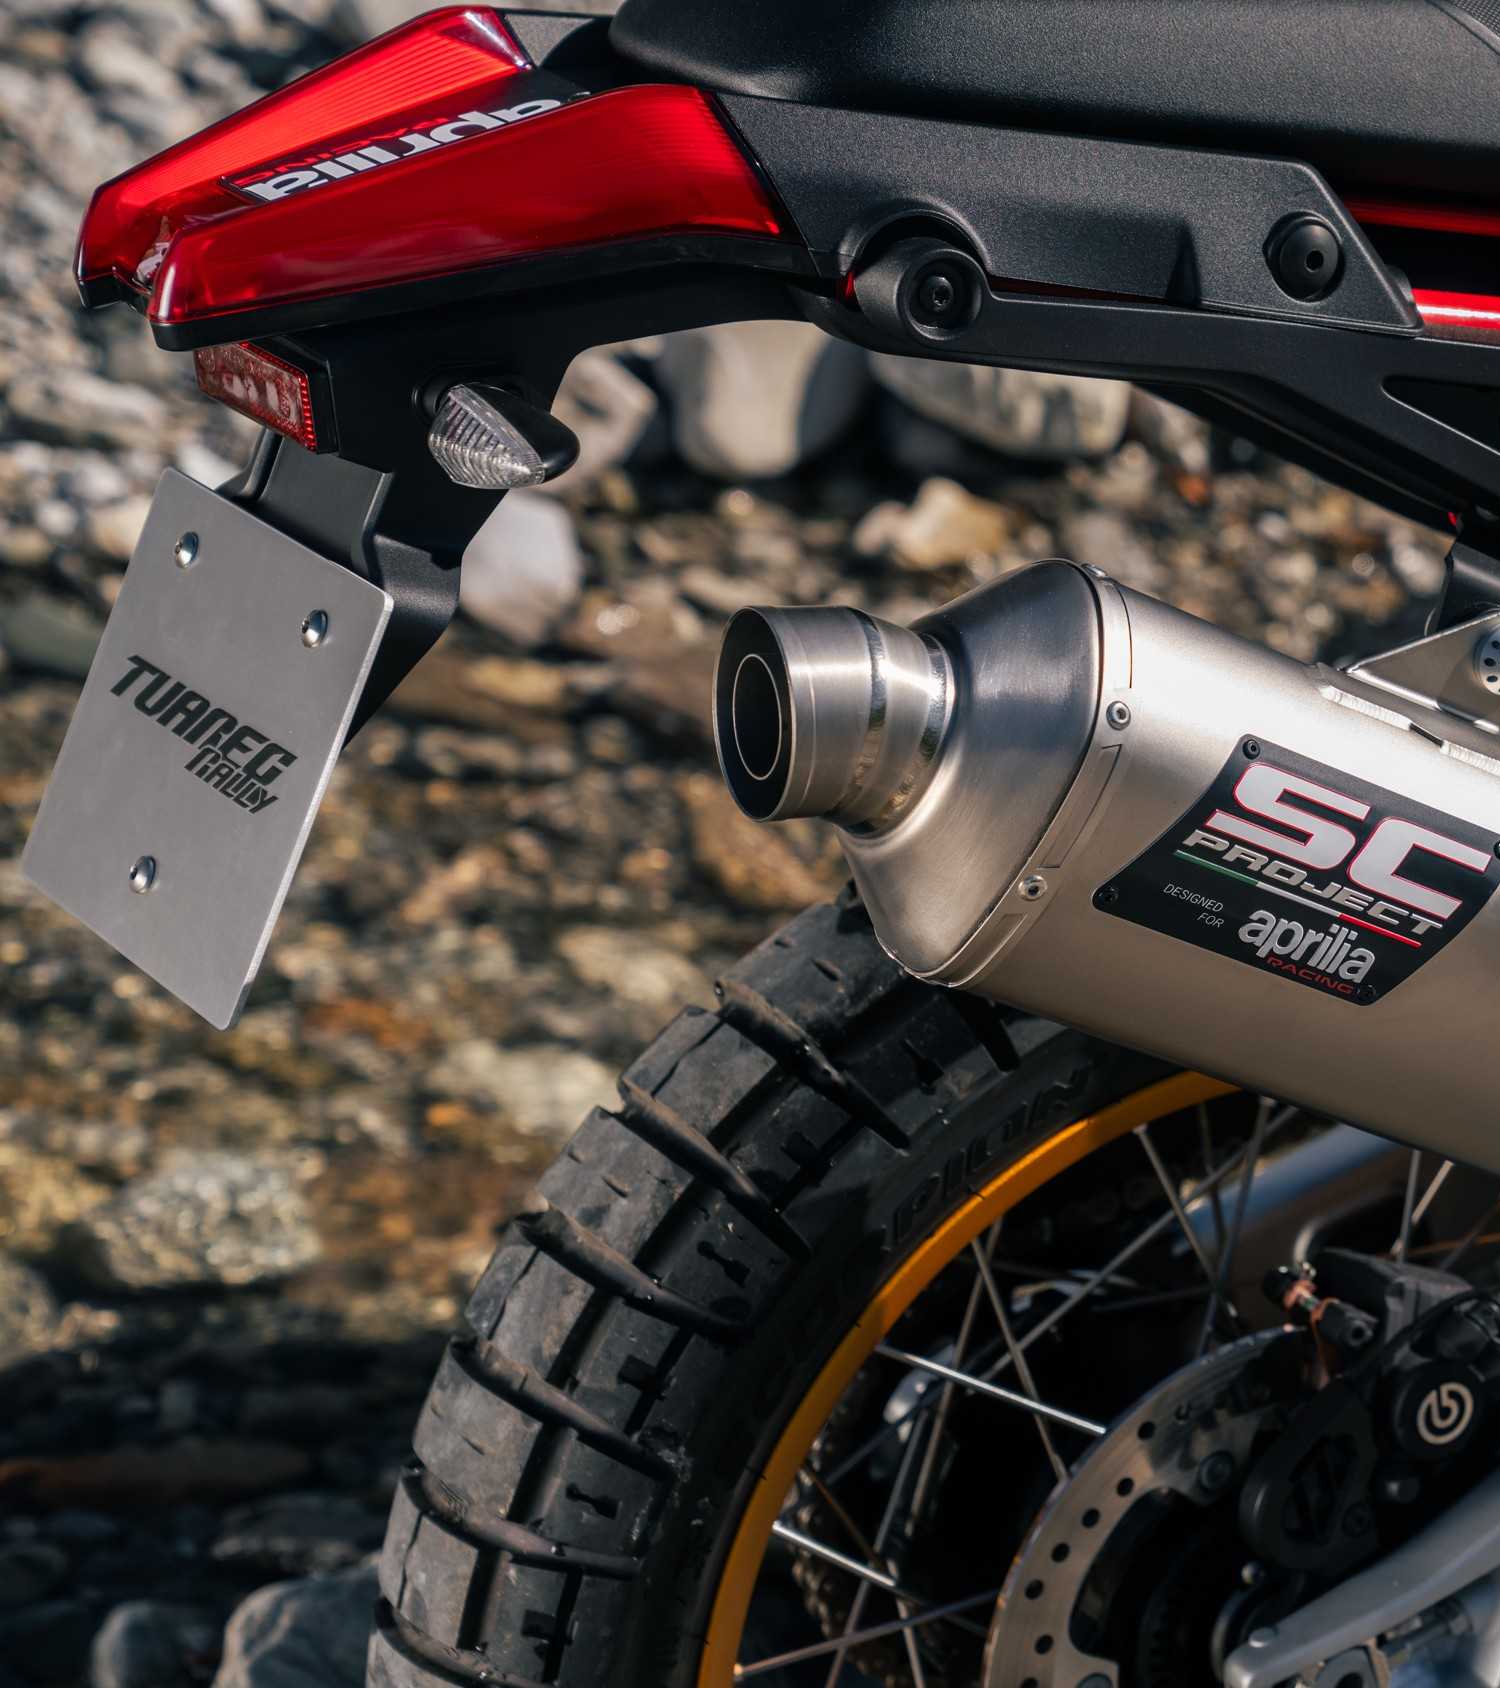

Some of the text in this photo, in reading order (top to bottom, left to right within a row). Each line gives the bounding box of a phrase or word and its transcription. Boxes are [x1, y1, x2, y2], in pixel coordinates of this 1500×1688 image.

[244, 99, 561, 200] aprilia
[110, 655, 298, 785] TUAREG
[1183, 829, 1443, 935] PROJECT
[1205, 761, 1493, 920] SC
[1163, 882, 1224, 913] DESIGNED
[1197, 912, 1225, 929] FOR
[1238, 909, 1375, 984] aprilia
[1266, 956, 1354, 996] RACING
